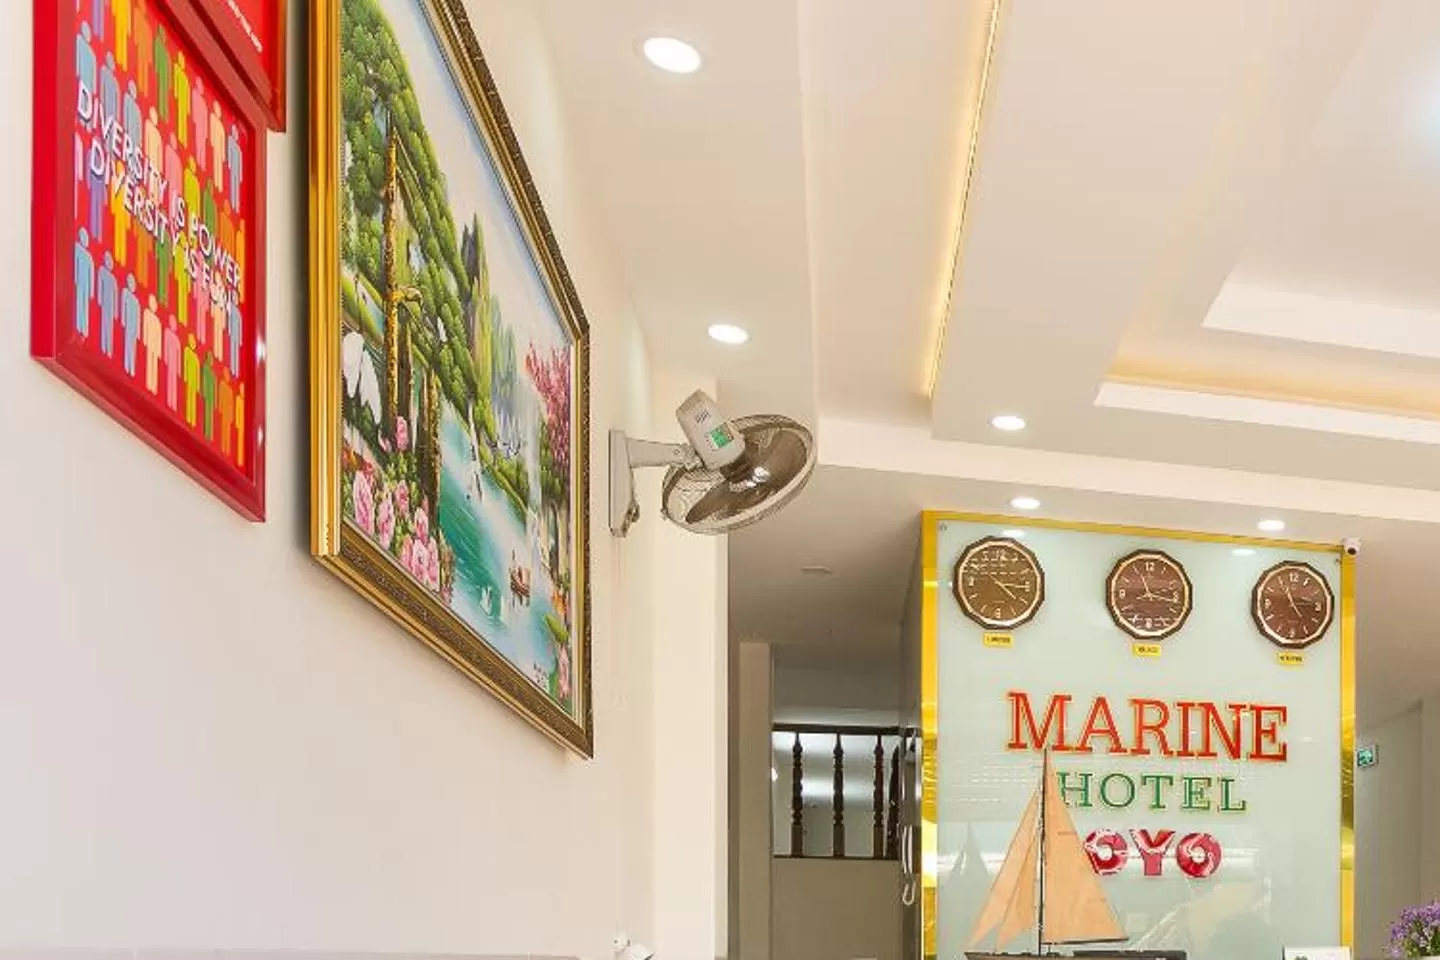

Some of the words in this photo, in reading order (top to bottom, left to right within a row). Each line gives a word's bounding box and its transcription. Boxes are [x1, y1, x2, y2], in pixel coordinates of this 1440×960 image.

[78, 80, 169, 205] DIVERSITY
[170, 189, 185, 227] IS
[190, 210, 241, 284] POWER
[90, 137, 179, 257] DIVERSITY
[1007, 691, 1288, 762] MARINE
[1057, 771, 1247, 812] HOTEL
[1083, 829, 1223, 878] OYO
